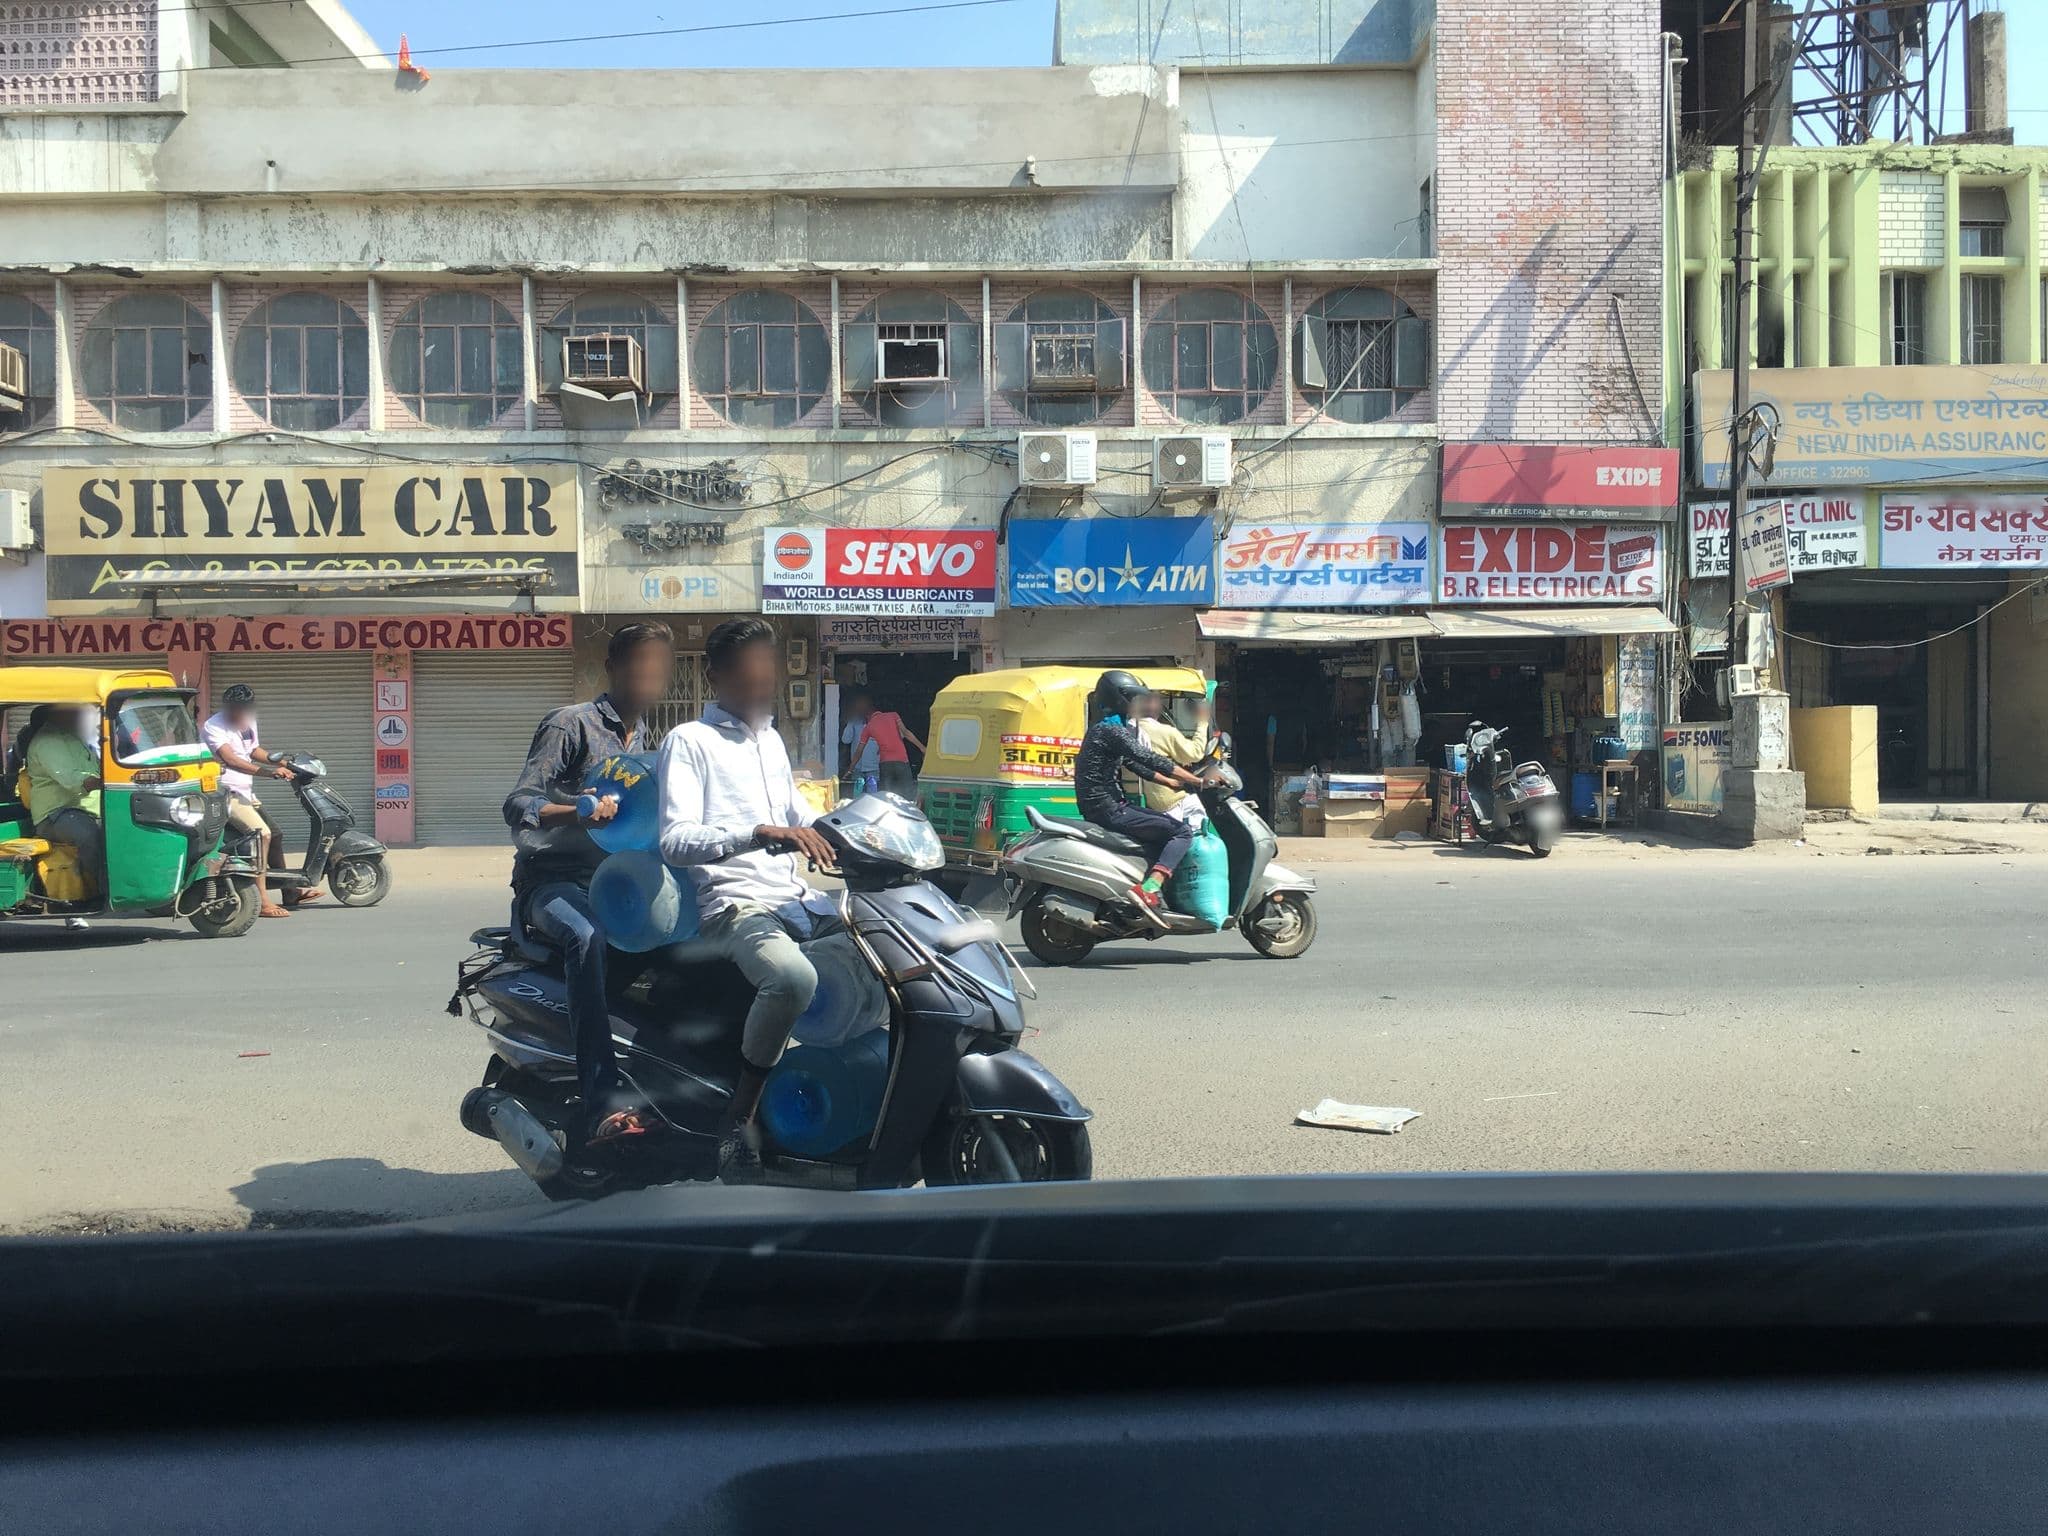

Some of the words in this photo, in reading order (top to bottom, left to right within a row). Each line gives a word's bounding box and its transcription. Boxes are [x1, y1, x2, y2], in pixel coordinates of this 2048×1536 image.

[1792, 399, 1840, 428] न्यू
[1842, 393, 1924, 427] इंडिया
[1797, 434, 1849, 455] NEW
[1855, 432, 1914, 453] INDIA
[1596, 467, 1662, 486] EXIDE
[80, 478, 365, 539] SHYAM
[394, 477, 557, 537] CAR
[1799, 501, 1857, 523] CLINIC
[840, 540, 976, 577] SERVO
[1443, 526, 1607, 573] EXIDE
[1619, 552, 1644, 562] EXIDE
[1937, 544, 1976, 561] नेत्र
[1980, 544, 2044, 561] सर्जन
[774, 572, 813, 580] IndianOil
[1055, 567, 1105, 593] BOI
[1147, 565, 1207, 592] ATM
[784, 586, 836, 599] WORLD
[838, 587, 884, 600] CLASS
[887, 589, 975, 601] LUBRICANTS
[6, 623, 131, 654] SHYAM
[141, 622, 217, 651] CAR
[229, 621, 294, 651] A.C.
[300, 621, 325, 650] &
[334, 619, 567, 650] DECORATORS
[1678, 731, 1692, 746] SF
[381, 754, 404, 769] JBL
[376, 801, 409, 810] SONY
